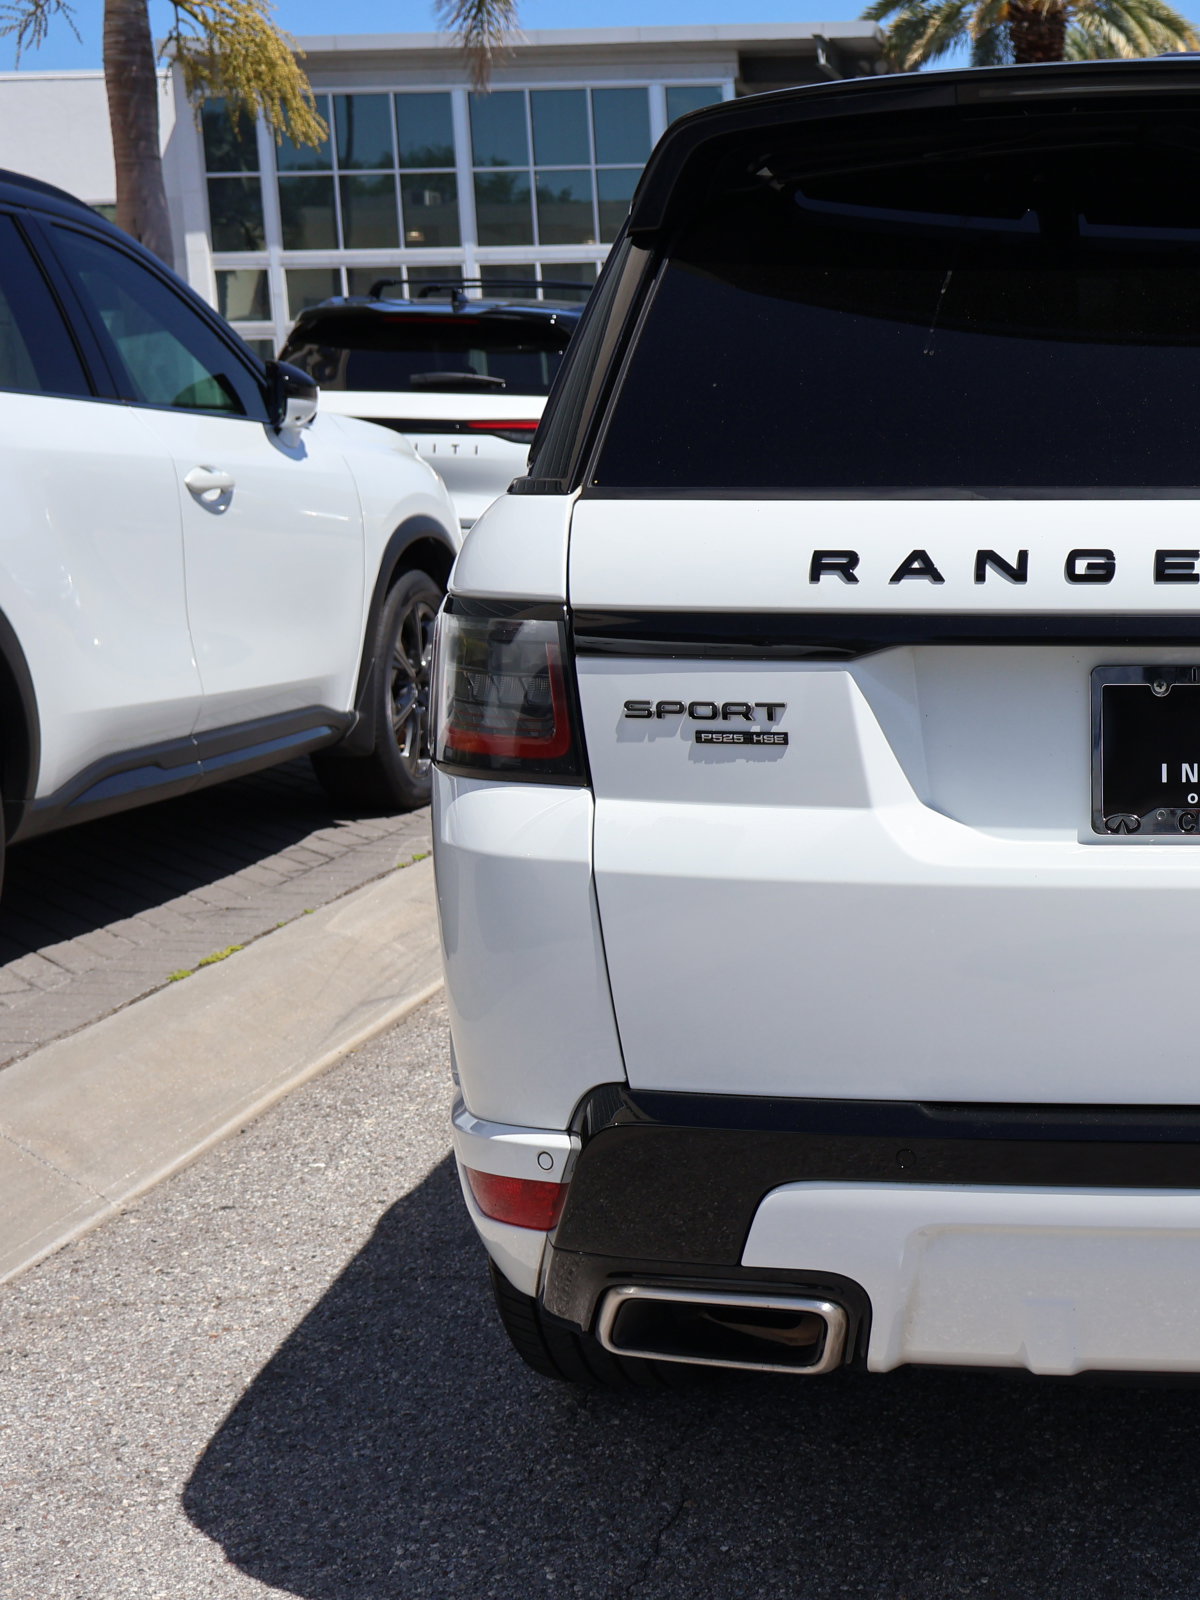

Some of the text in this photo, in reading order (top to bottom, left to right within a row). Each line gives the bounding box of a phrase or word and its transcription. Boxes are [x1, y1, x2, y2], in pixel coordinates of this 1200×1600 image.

[808, 549, 1200, 584] RANGE
[624, 700, 786, 721] SPORT
[701, 732, 785, 743] P525 HSE
